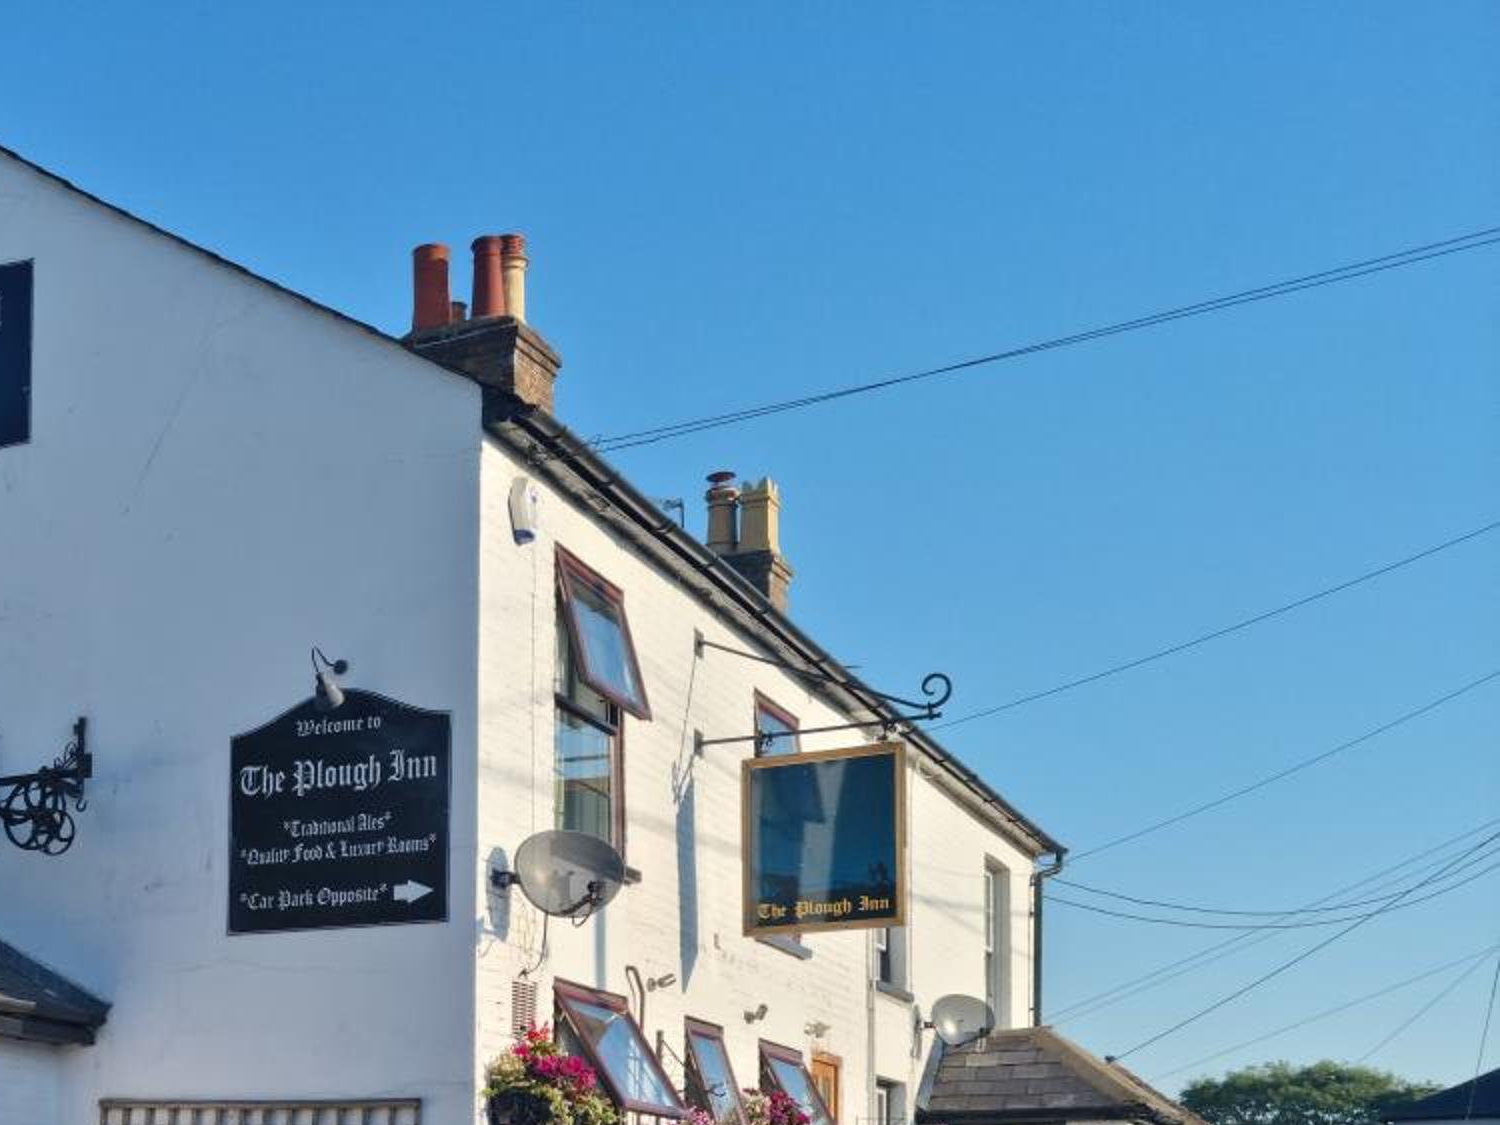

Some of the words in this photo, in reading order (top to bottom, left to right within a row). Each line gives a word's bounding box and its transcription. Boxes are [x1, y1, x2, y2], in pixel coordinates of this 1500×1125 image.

[296, 717, 364, 736] Welcome
[368, 716, 381, 729] to
[240, 765, 286, 800] The
[292, 755, 381, 797] Plough
[388, 749, 437, 782] Inn
[292, 844, 323, 863] Food
[325, 845, 337, 860] &
[340, 840, 385, 857] Luxury
[278, 891, 314, 911] Park
[794, 897, 852, 919] Plough
[858, 895, 889, 911] Inn
